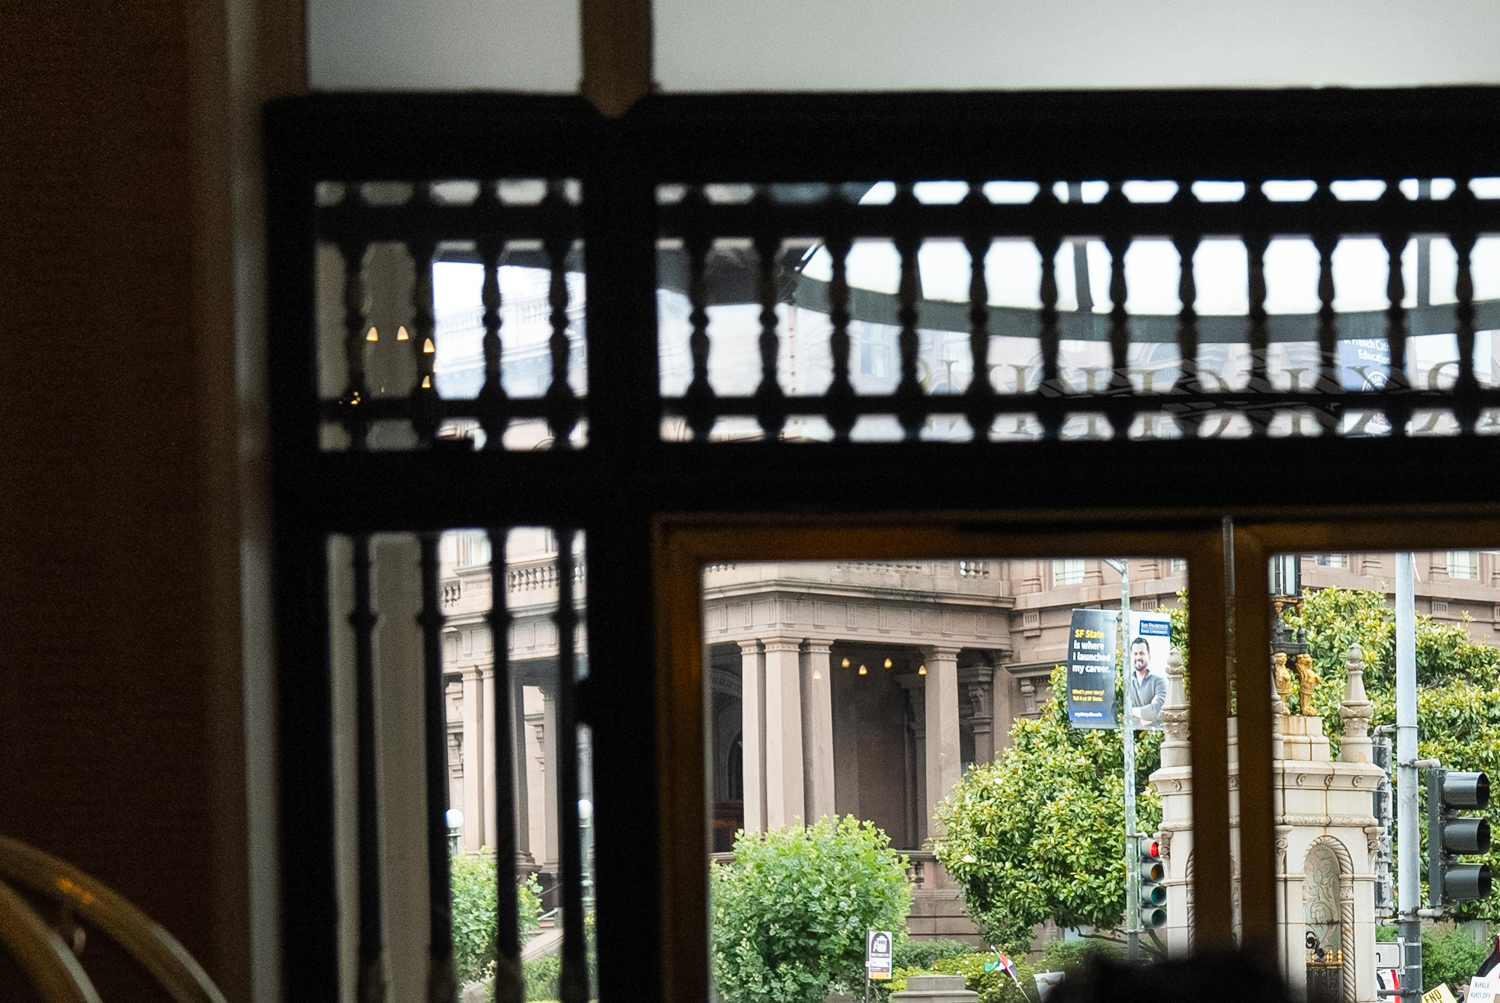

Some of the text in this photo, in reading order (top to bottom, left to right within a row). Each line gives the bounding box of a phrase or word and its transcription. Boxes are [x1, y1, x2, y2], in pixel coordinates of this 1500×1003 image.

[1352, 339, 1375, 349] French
[1358, 349, 1389, 364] Education
[1074, 629, 1105, 639] SF State
[1074, 640, 1104, 650] is where
[1073, 652, 1110, 662] I launched
[1072, 665, 1110, 674] my career.
